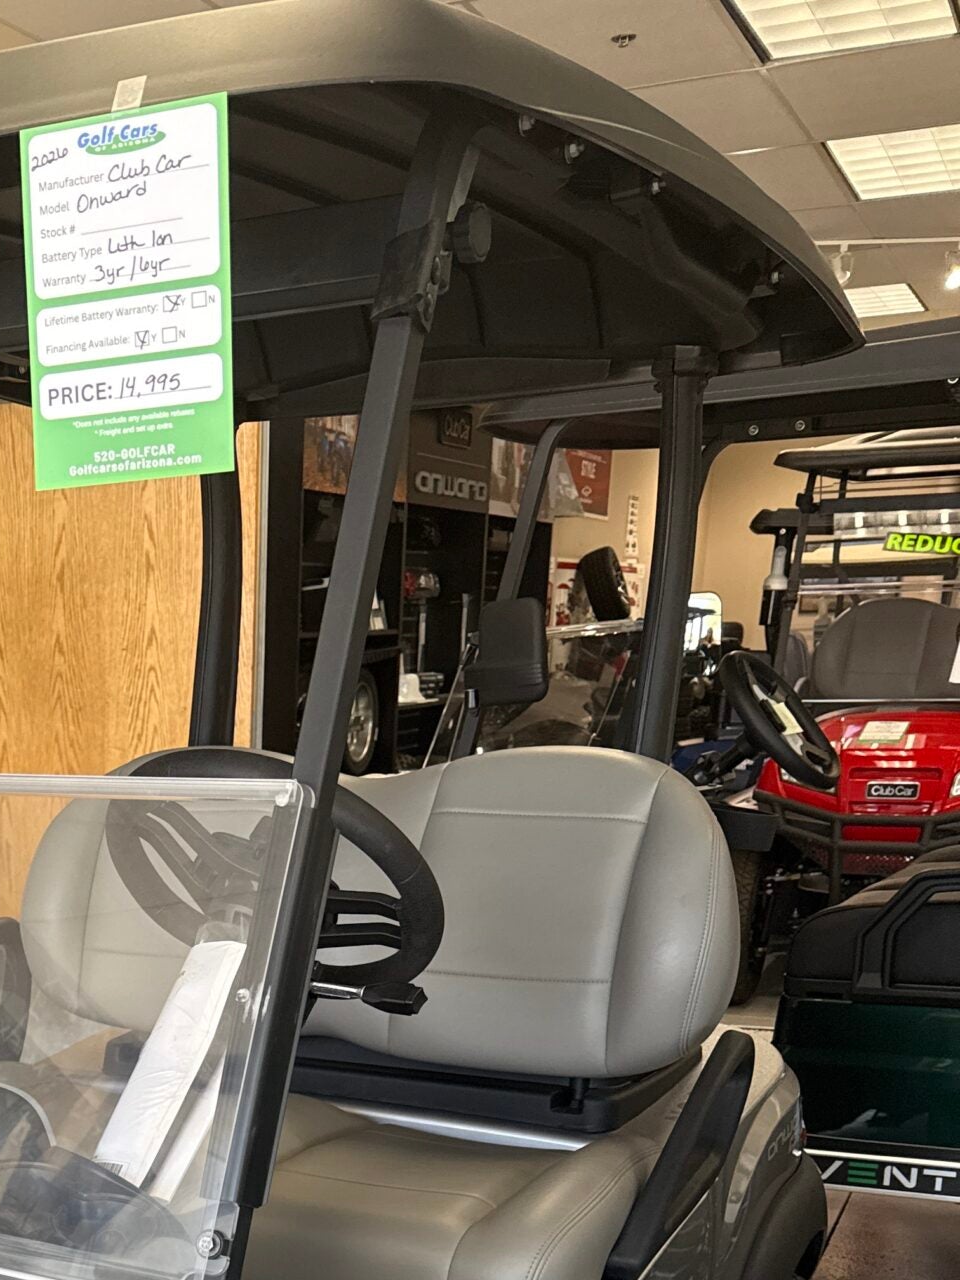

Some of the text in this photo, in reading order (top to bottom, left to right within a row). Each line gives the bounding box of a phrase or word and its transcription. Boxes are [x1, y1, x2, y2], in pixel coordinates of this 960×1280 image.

[77, 123, 158, 149] Golf Cars
[31, 148, 69, 172] 2026
[38, 154, 192, 192] Manufacturer Club Car
[39, 181, 147, 216] Model Onward
[40, 225, 76, 239] Stock #
[41, 250, 77, 264] Battery
[79, 245, 103, 260] Type
[42, 272, 87, 288] Warranty
[44, 312, 80, 327] Lifetime
[81, 307, 114, 322] Battery
[115, 303, 159, 318] Warranty:
[208, 295, 216, 303] N
[45, 341, 87, 354] Financing
[88, 335, 130, 349] Available:
[178, 330, 186, 338] N
[48, 373, 181, 406] PRICE: 14,995
[104, 415, 128, 425] include
[128, 415, 141, 424] any
[122, 425, 135, 433] and
[136, 424, 146, 432] set
[146, 424, 156, 433] up
[93, 443, 176, 462] 520-GOLFCAR
[69, 454, 202, 476] Golfcarsofarizona.com
[871, 785, 914, 796] Club Car
